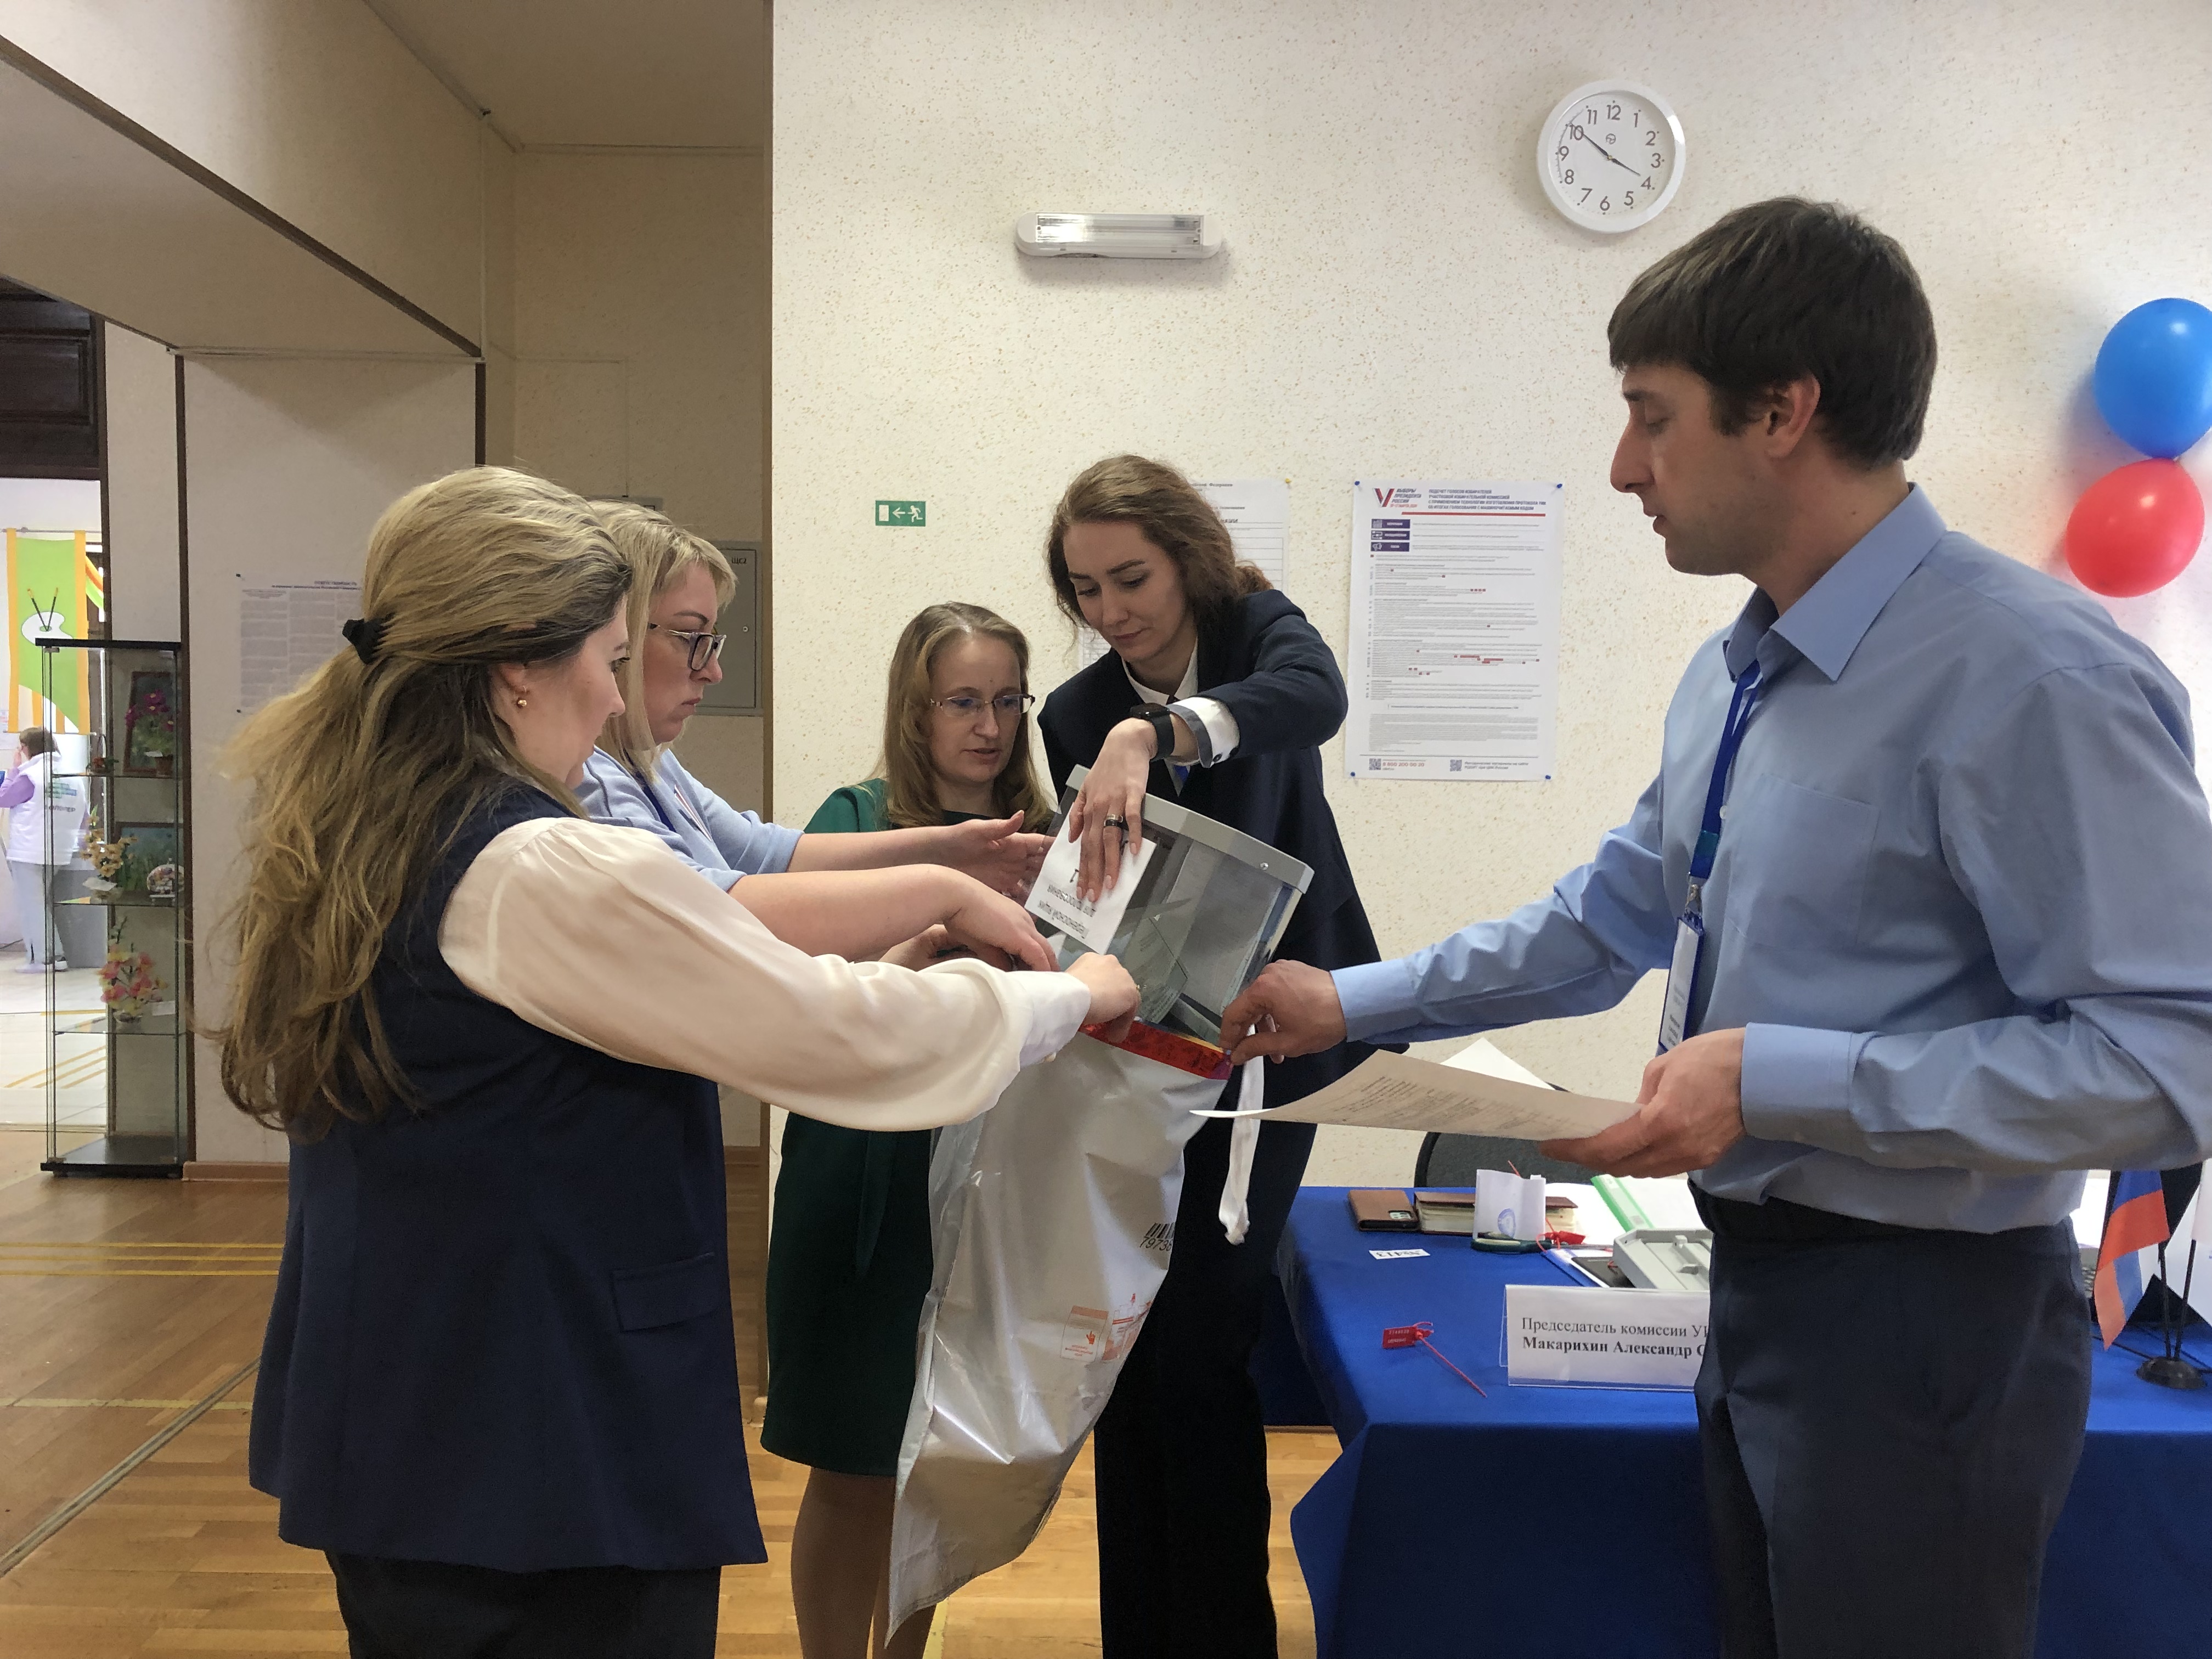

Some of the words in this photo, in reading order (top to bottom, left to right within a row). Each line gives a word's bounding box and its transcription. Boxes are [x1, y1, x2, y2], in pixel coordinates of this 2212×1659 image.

[1587, 109, 1597, 125] 11
[1606, 104, 1621, 120] 12
[1634, 112, 1638, 128] 1
[1569, 124, 1584, 140] 10
[1645, 131, 1656, 146] 2
[1559, 145, 1569, 161] 9
[1651, 153, 1661, 168] 3
[1564, 169, 1575, 185] 8
[1640, 176, 1651, 190] 4
[1581, 188, 1593, 203] 7
[1600, 196, 1610, 211] 6
[1624, 191, 1634, 206] 5
[1522, 1317, 1616, 1334] Председатель
[1621, 1325, 1687, 1337] комиссии
[1523, 1336, 1608, 1354] Макарихин
[1613, 1341, 1692, 1359] Александр
